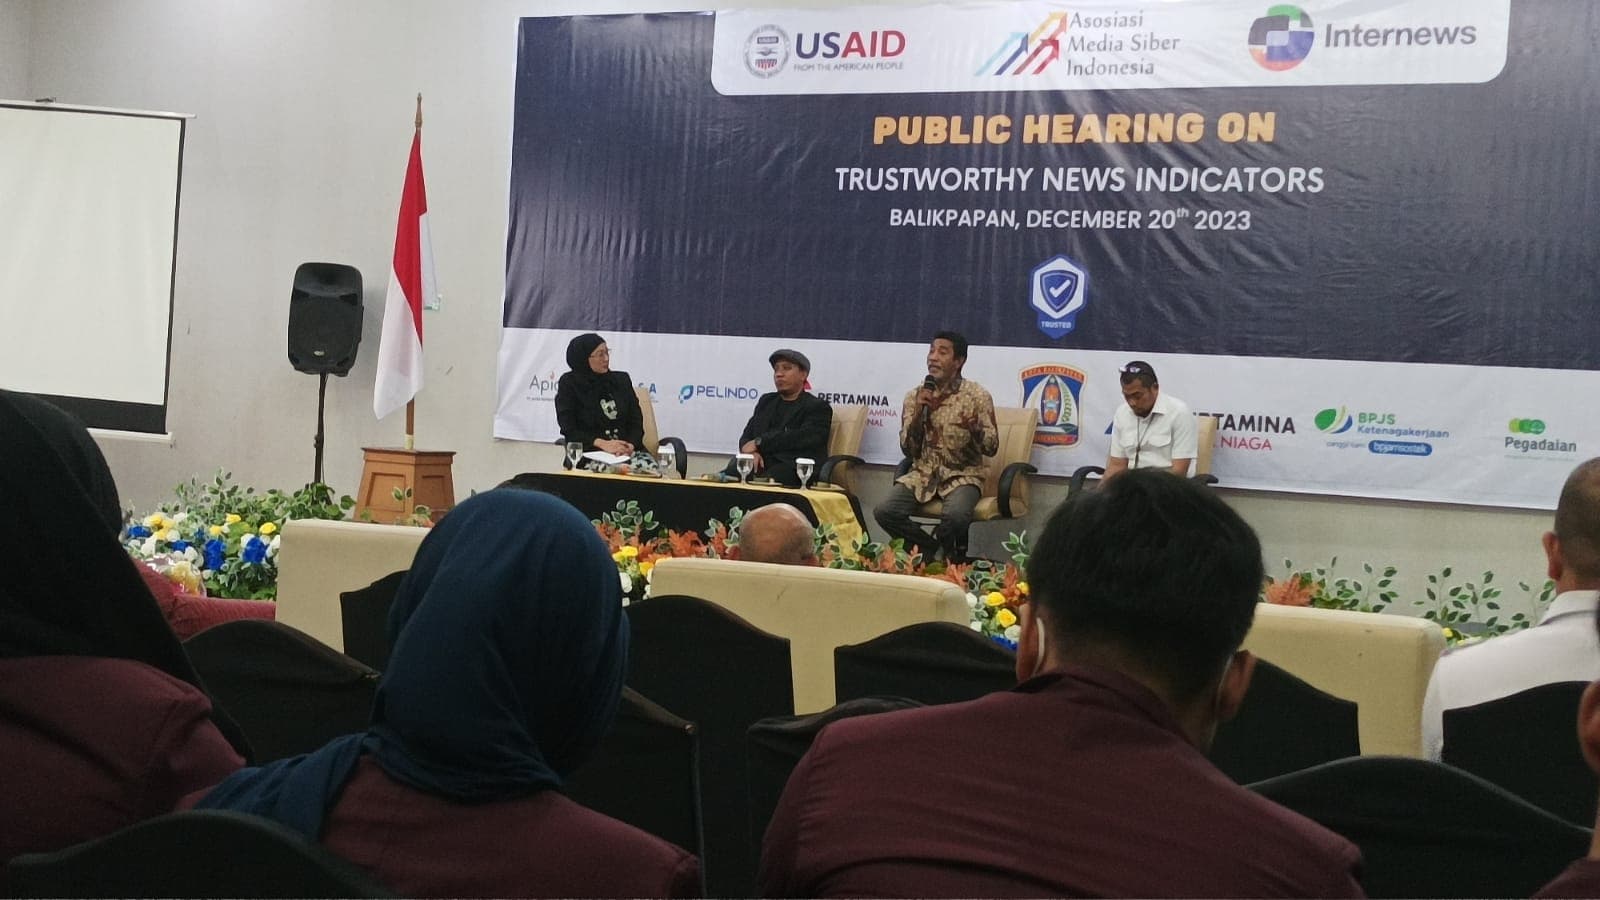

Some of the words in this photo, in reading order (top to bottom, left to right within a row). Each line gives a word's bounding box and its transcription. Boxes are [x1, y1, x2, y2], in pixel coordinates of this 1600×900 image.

[1069, 10, 1144, 28] Asosiasi
[796, 30, 905, 59] USAID
[1067, 34, 1124, 53] Media
[1130, 32, 1180, 51] Siber
[1324, 23, 1477, 48] Internews
[794, 64, 816, 72] FROM
[817, 63, 831, 71] THE
[833, 62, 874, 71] AMERICAN
[876, 61, 904, 70] PEOPLE
[1066, 57, 1154, 76] Indonesia
[873, 115, 1011, 145] PUBLIC
[1022, 113, 1204, 144] HEARING
[1217, 111, 1276, 142] ON
[835, 167, 1034, 192] TRUSTWORTHY
[1041, 167, 1126, 192] NEWS
[1135, 167, 1325, 193] INDICATORS
[889, 208, 1021, 231] BALIKPAPAN,
[1026, 209, 1142, 230] DECEMBER
[1147, 207, 1189, 230] 20th
[1194, 210, 1251, 230] 2023
[1040, 320, 1072, 329] TRUSTED
[696, 385, 758, 400] PELINDO
[1193, 412, 1296, 434] TAMINA
[1358, 412, 1396, 425] BPJS
[1357, 425, 1450, 439] Ketenagakerjaan
[1220, 436, 1272, 451] NIAGA
[1504, 436, 1577, 453] Pegadaian
